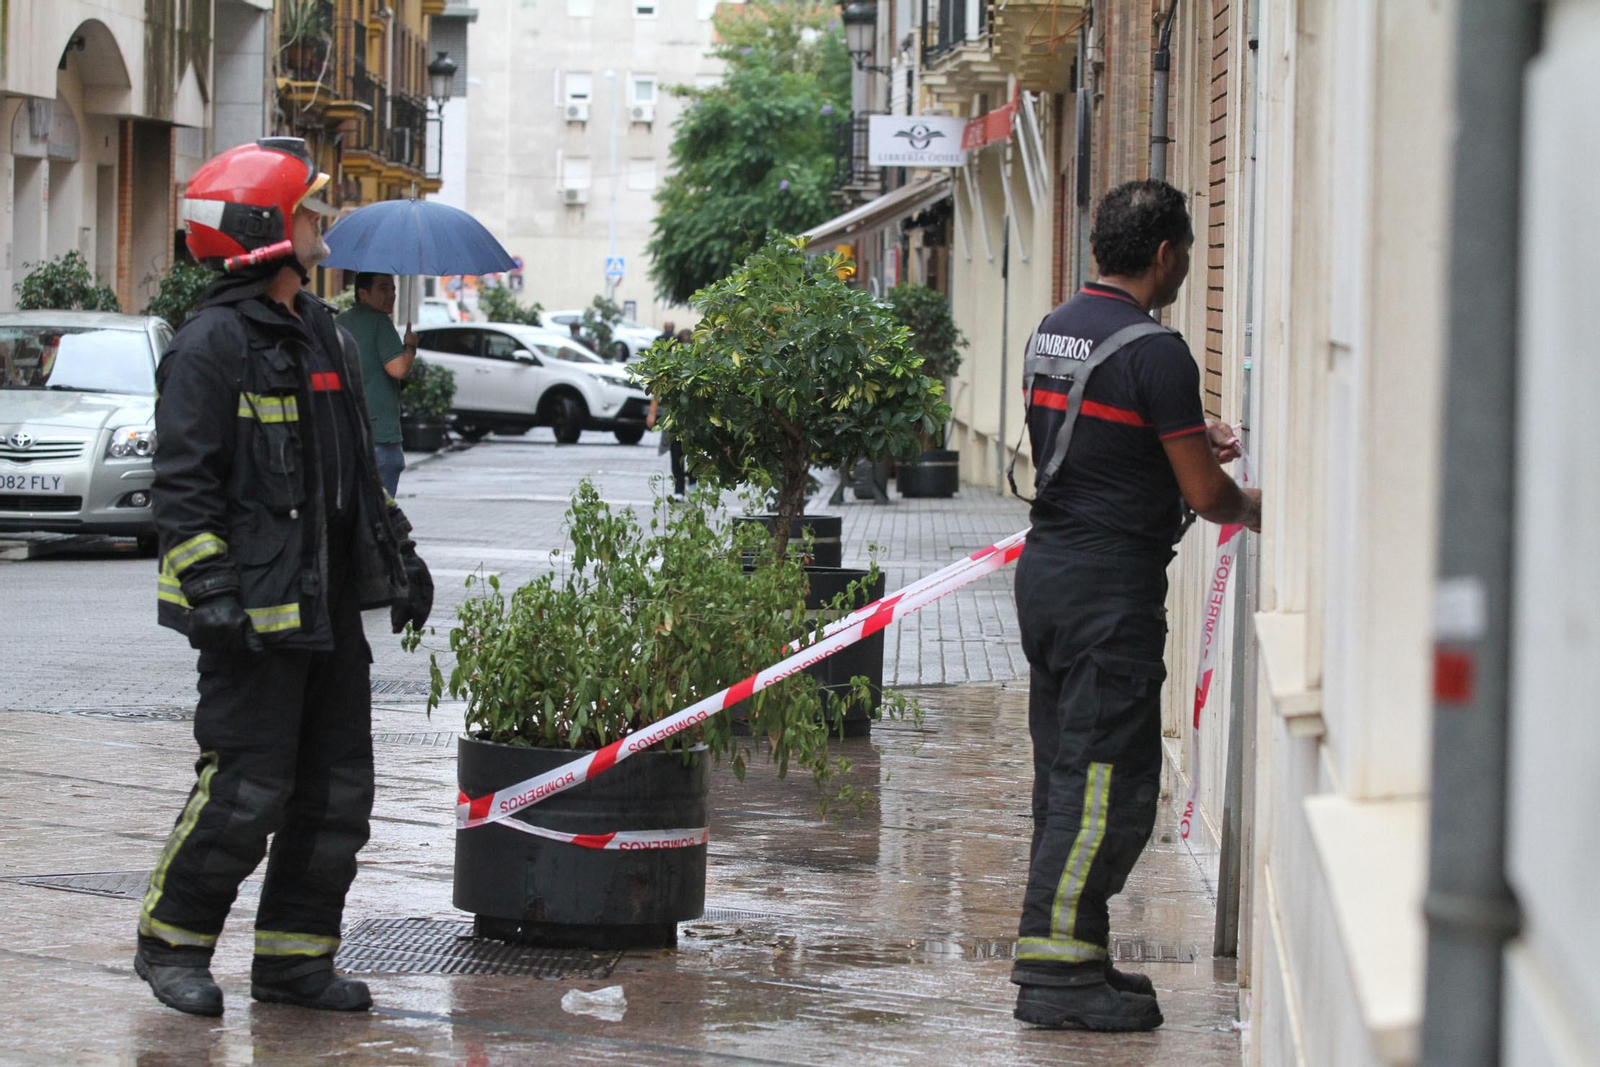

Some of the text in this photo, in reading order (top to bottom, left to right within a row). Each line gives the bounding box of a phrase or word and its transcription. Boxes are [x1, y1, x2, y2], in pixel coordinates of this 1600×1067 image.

[31, 476, 61, 490] FLY
[627, 710, 709, 753] BOMBEROS
[499, 771, 576, 814] BOMBEROS
